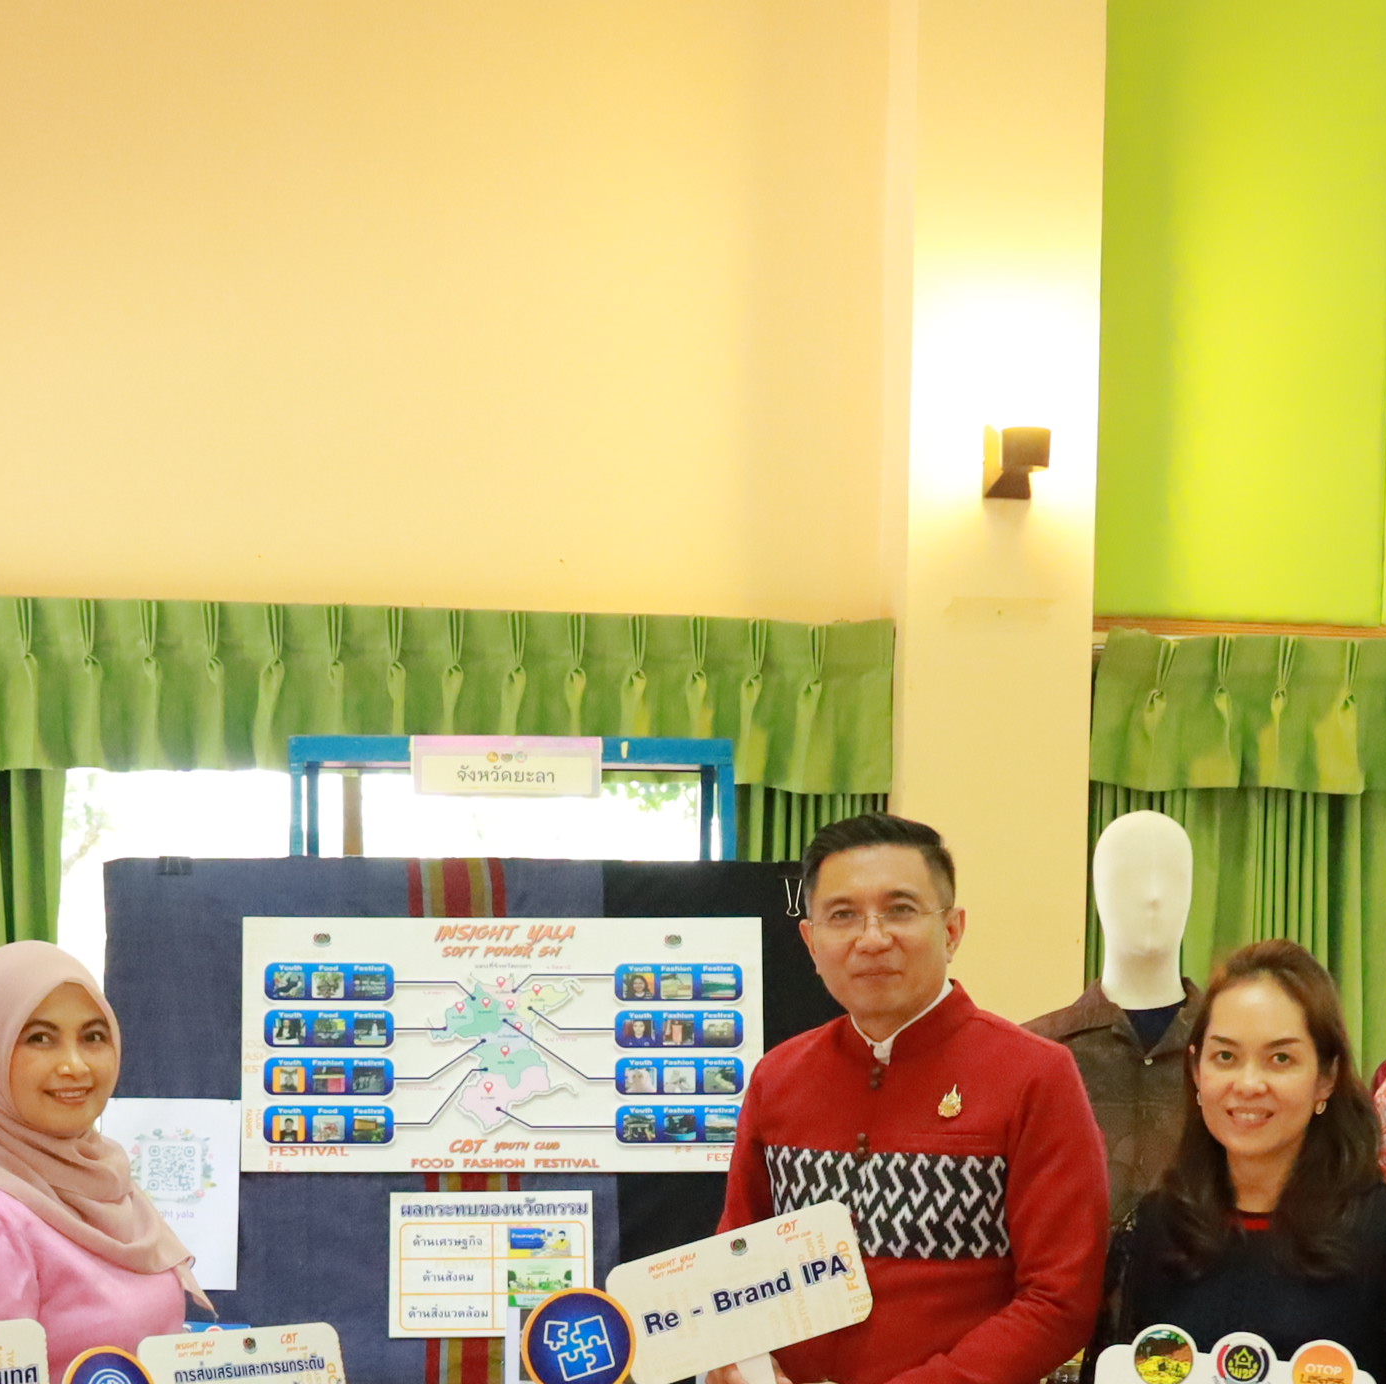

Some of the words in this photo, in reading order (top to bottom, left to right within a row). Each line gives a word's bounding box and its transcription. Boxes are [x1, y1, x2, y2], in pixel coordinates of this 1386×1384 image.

[456, 764, 555, 783] จังหวัดยะลา
[435, 924, 520, 942] INSIGHT
[527, 924, 575, 946] YALA
[442, 945, 479, 957] SOFT
[483, 945, 533, 958] POWER
[278, 964, 302, 972] Youth
[278, 1059, 302, 1067] Youth
[629, 1059, 653, 1067] Youth
[278, 1107, 302, 1115] Youth
[630, 1107, 653, 1115] Youth
[269, 1146, 349, 1157] FESTIVAL
[449, 1138, 488, 1154] CBT
[494, 1141, 530, 1152] YOUTH
[534, 1141, 561, 1150] CLUB
[411, 1158, 455, 1169] FOOD
[463, 1158, 525, 1169] FASHION
[534, 1158, 600, 1169] FESTIVAL
[401, 1198, 588, 1217] ผลกระทบของนวัตกรรม
[413, 1234, 483, 1250] ด้านเศรษฐกิจ
[422, 1270, 474, 1282] ด้านสังคม
[645, 1309, 680, 1335] Re
[713, 1272, 791, 1313] Brand
[802, 1254, 848, 1284] IPA
[408, 1304, 489, 1319] ด้านสิ่งแวดล้อม
[175, 1355, 325, 1383] การส่งเสริมและการยกระดับ
[1305, 1363, 1343, 1376] OTOP
